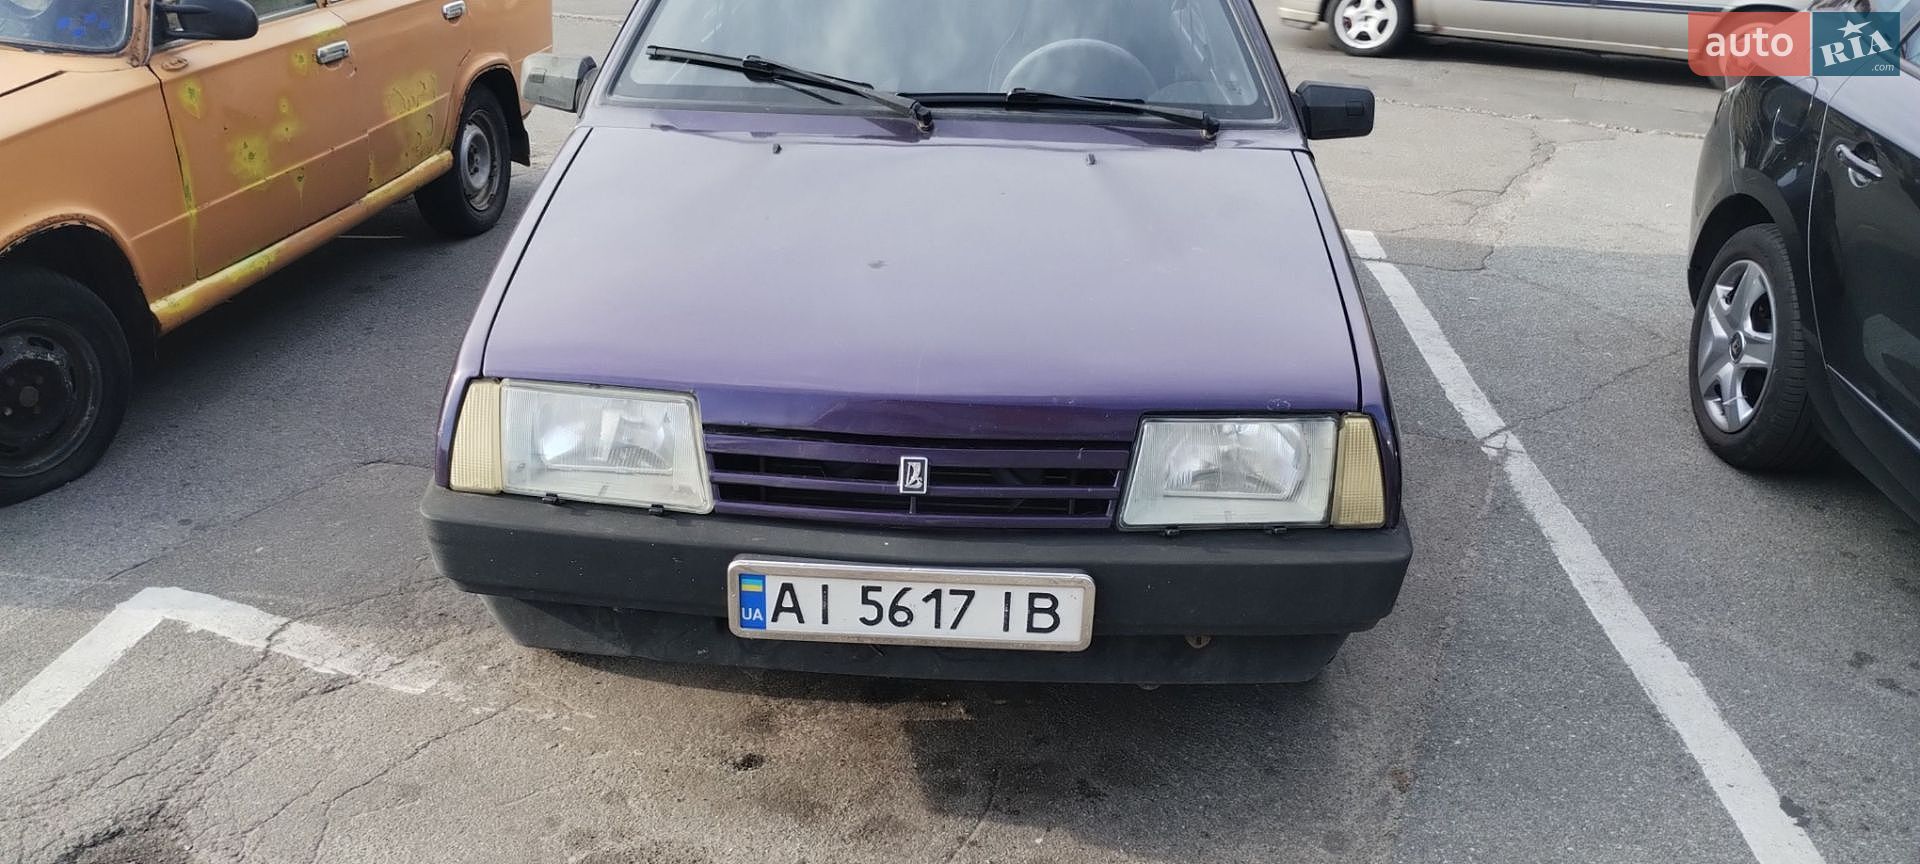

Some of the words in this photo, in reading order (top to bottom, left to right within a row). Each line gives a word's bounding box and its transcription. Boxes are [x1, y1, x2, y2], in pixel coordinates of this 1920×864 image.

[741, 606, 764, 622] UA
[858, 584, 976, 630] 5617
[1002, 590, 1061, 634] IB
